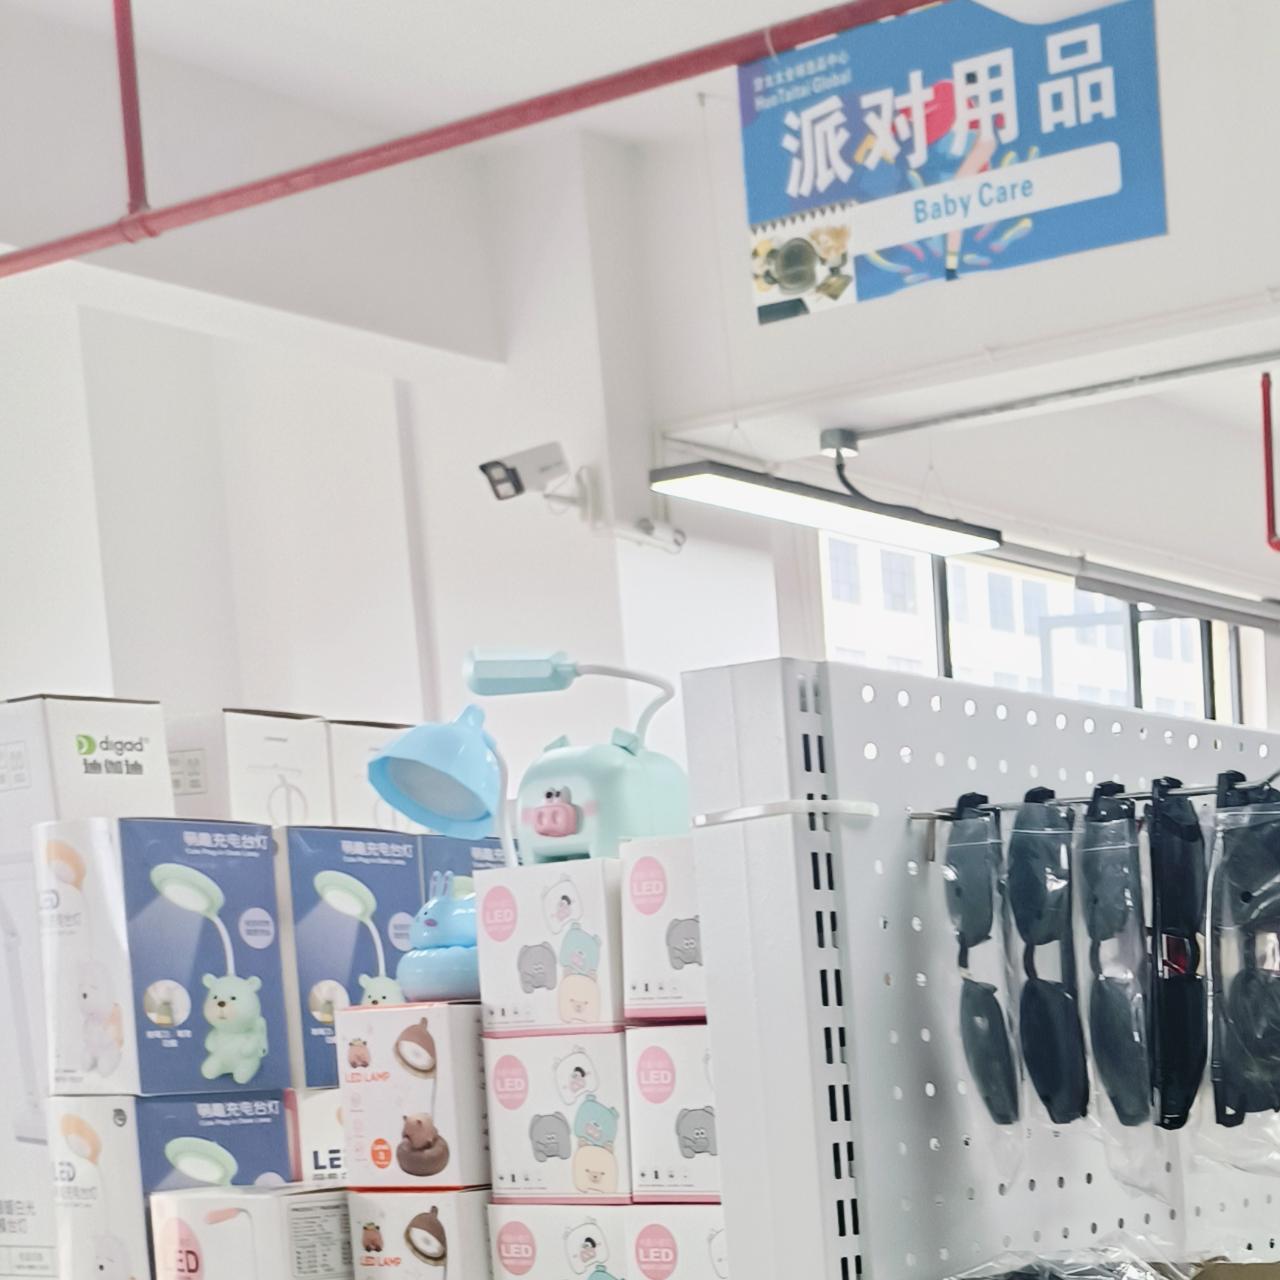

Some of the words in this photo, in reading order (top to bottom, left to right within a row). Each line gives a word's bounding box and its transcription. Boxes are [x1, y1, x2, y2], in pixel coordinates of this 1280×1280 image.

[780, 23, 1117, 199] 派对用品
[913, 190, 971, 225] Baby
[978, 178, 1034, 207] Care
[633, 880, 666, 896] LED
[495, 1077, 526, 1091] LED
[640, 1069, 672, 1085] LED
[313, 1149, 342, 1169] LE
[499, 1242, 532, 1258] LED
[638, 1247, 674, 1263] LED
[177, 1249, 199, 1273] ED
